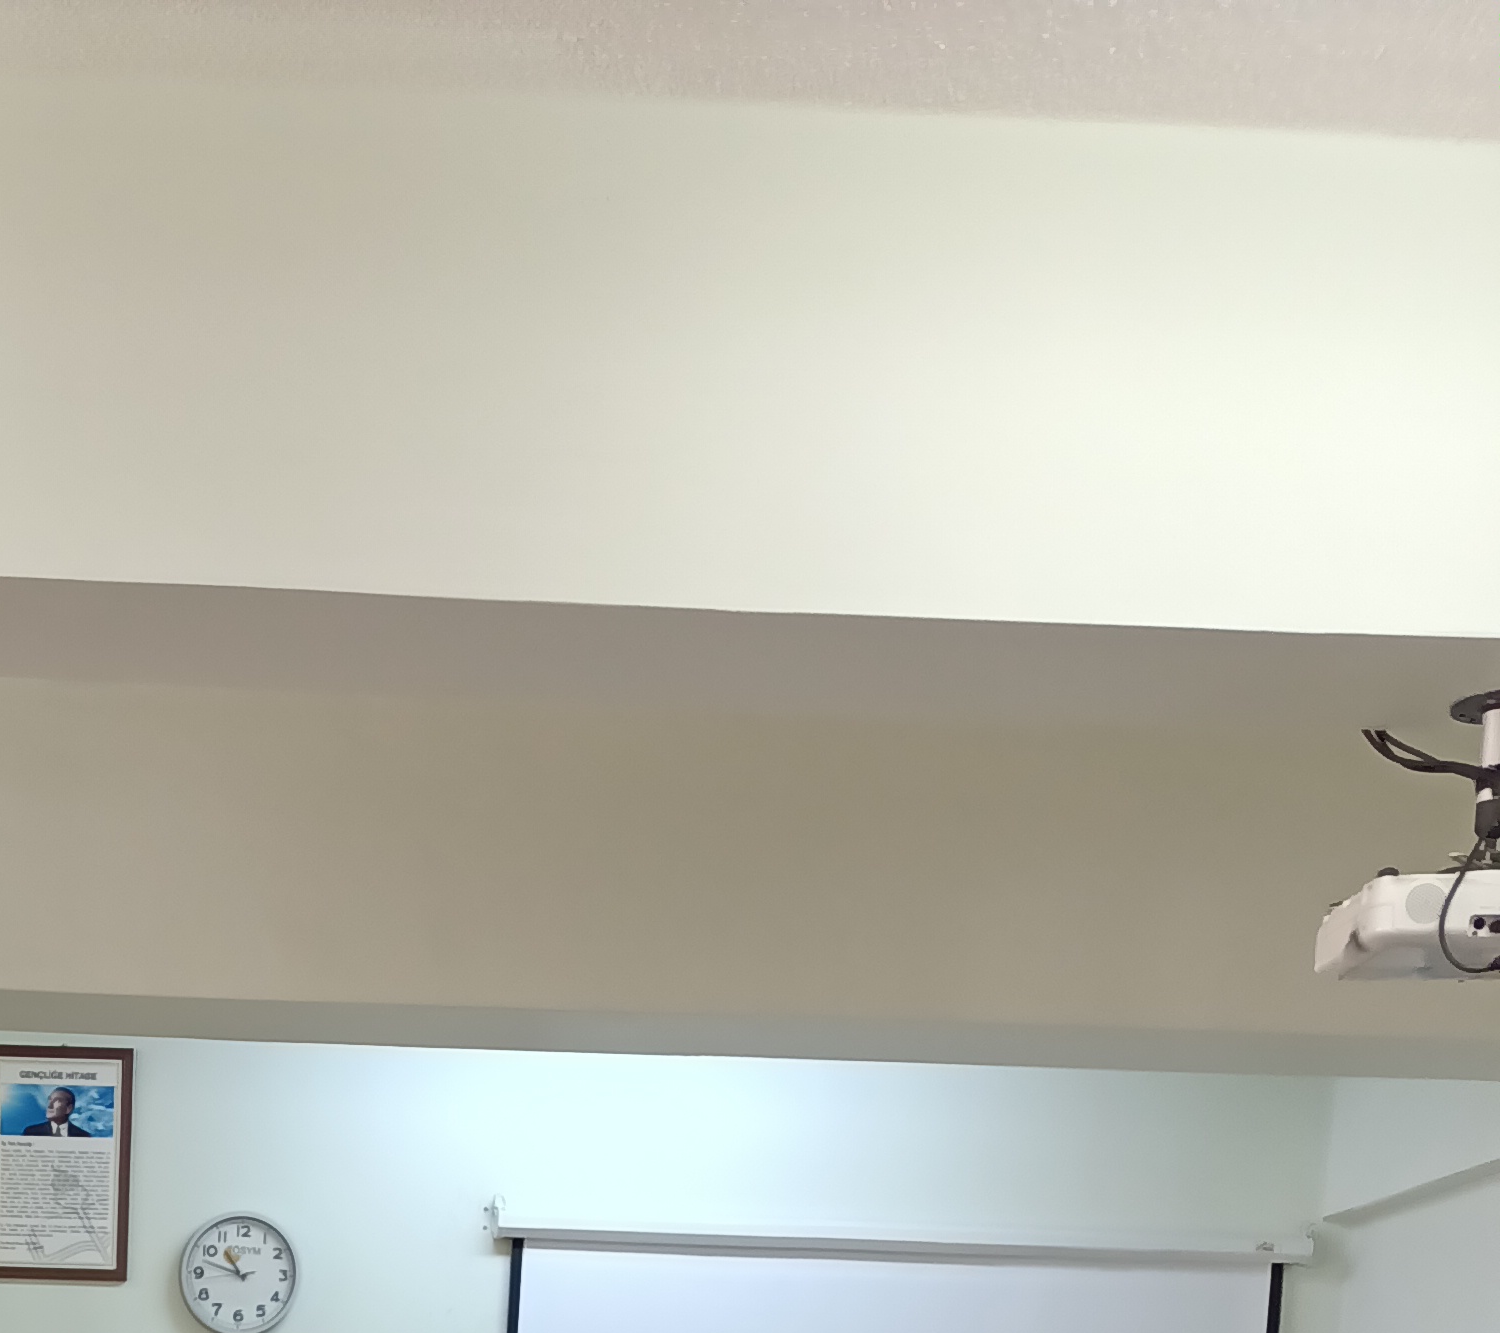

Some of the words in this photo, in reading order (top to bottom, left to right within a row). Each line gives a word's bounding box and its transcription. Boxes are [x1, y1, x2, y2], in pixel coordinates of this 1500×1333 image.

[217, 1230, 227, 1243] 11
[236, 1224, 251, 1238] 12
[202, 1244, 218, 1257] 10
[272, 1247, 283, 1260] 2
[193, 1265, 205, 1280] 9
[278, 1269, 288, 1282] 3
[197, 1287, 210, 1301] 8
[270, 1291, 280, 1302] 4
[211, 1302, 223, 1316] 7
[232, 1309, 244, 1322] 6
[255, 1304, 266, 1318] 5
